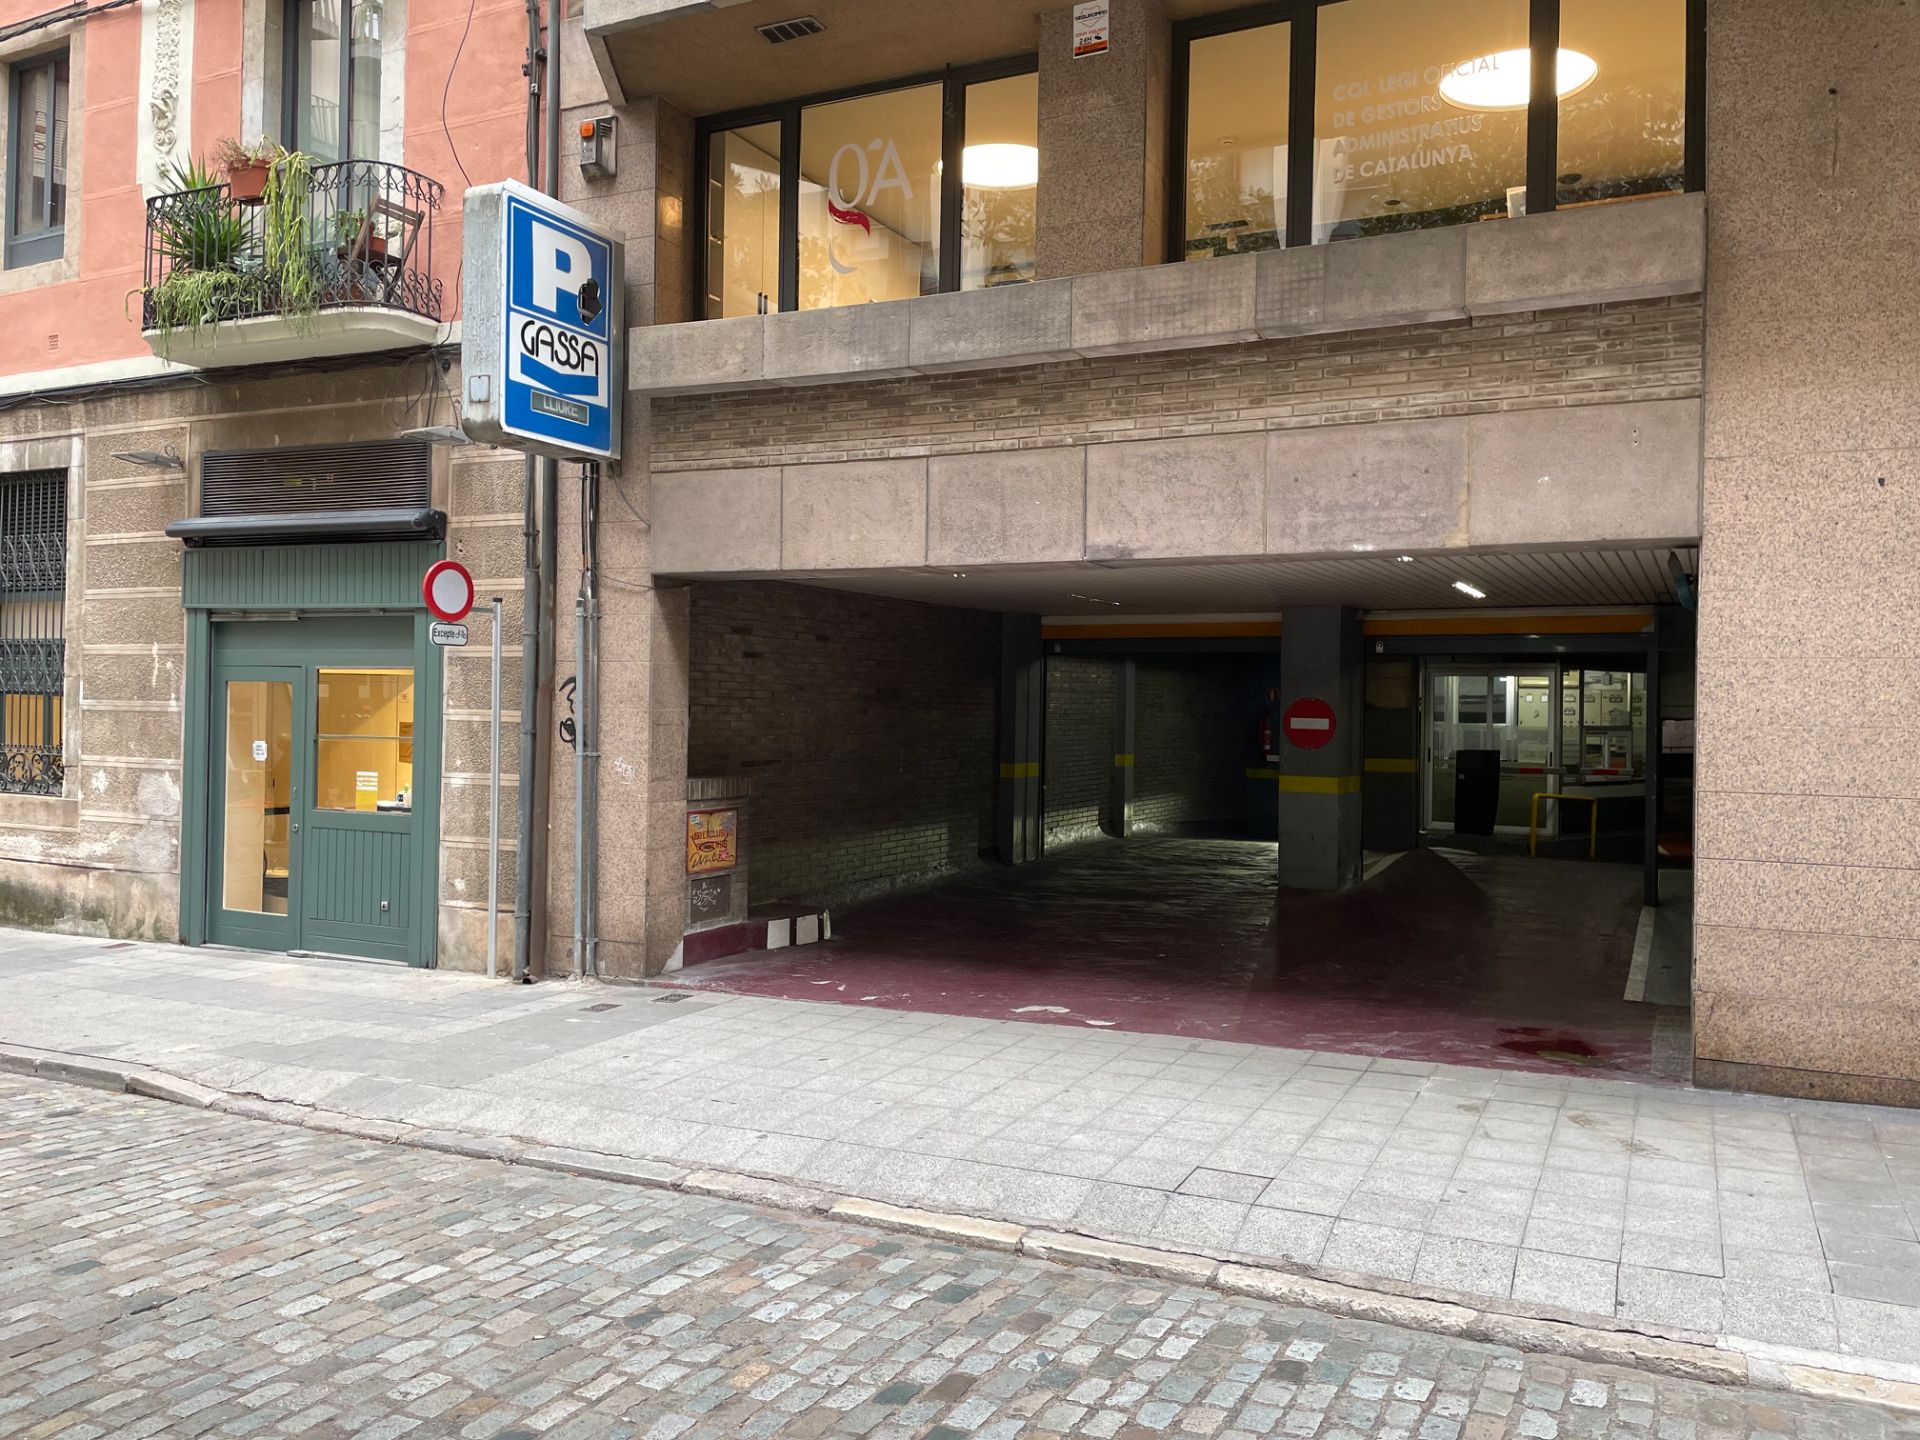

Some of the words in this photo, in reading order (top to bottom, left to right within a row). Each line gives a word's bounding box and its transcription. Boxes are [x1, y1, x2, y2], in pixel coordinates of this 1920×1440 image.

[1424, 55, 1501, 85] OFICIAL
[1333, 109, 1356, 129] DE
[1360, 94, 1442, 124] GESTORS
[1333, 113, 1483, 157] ADMINISTRATIUS
[1333, 164, 1355, 184] DE
[1360, 144, 1474, 177] CATALUNYA
[532, 219, 592, 313] P
[520, 319, 599, 376] GASSA
[433, 627, 455, 639] Excepte
